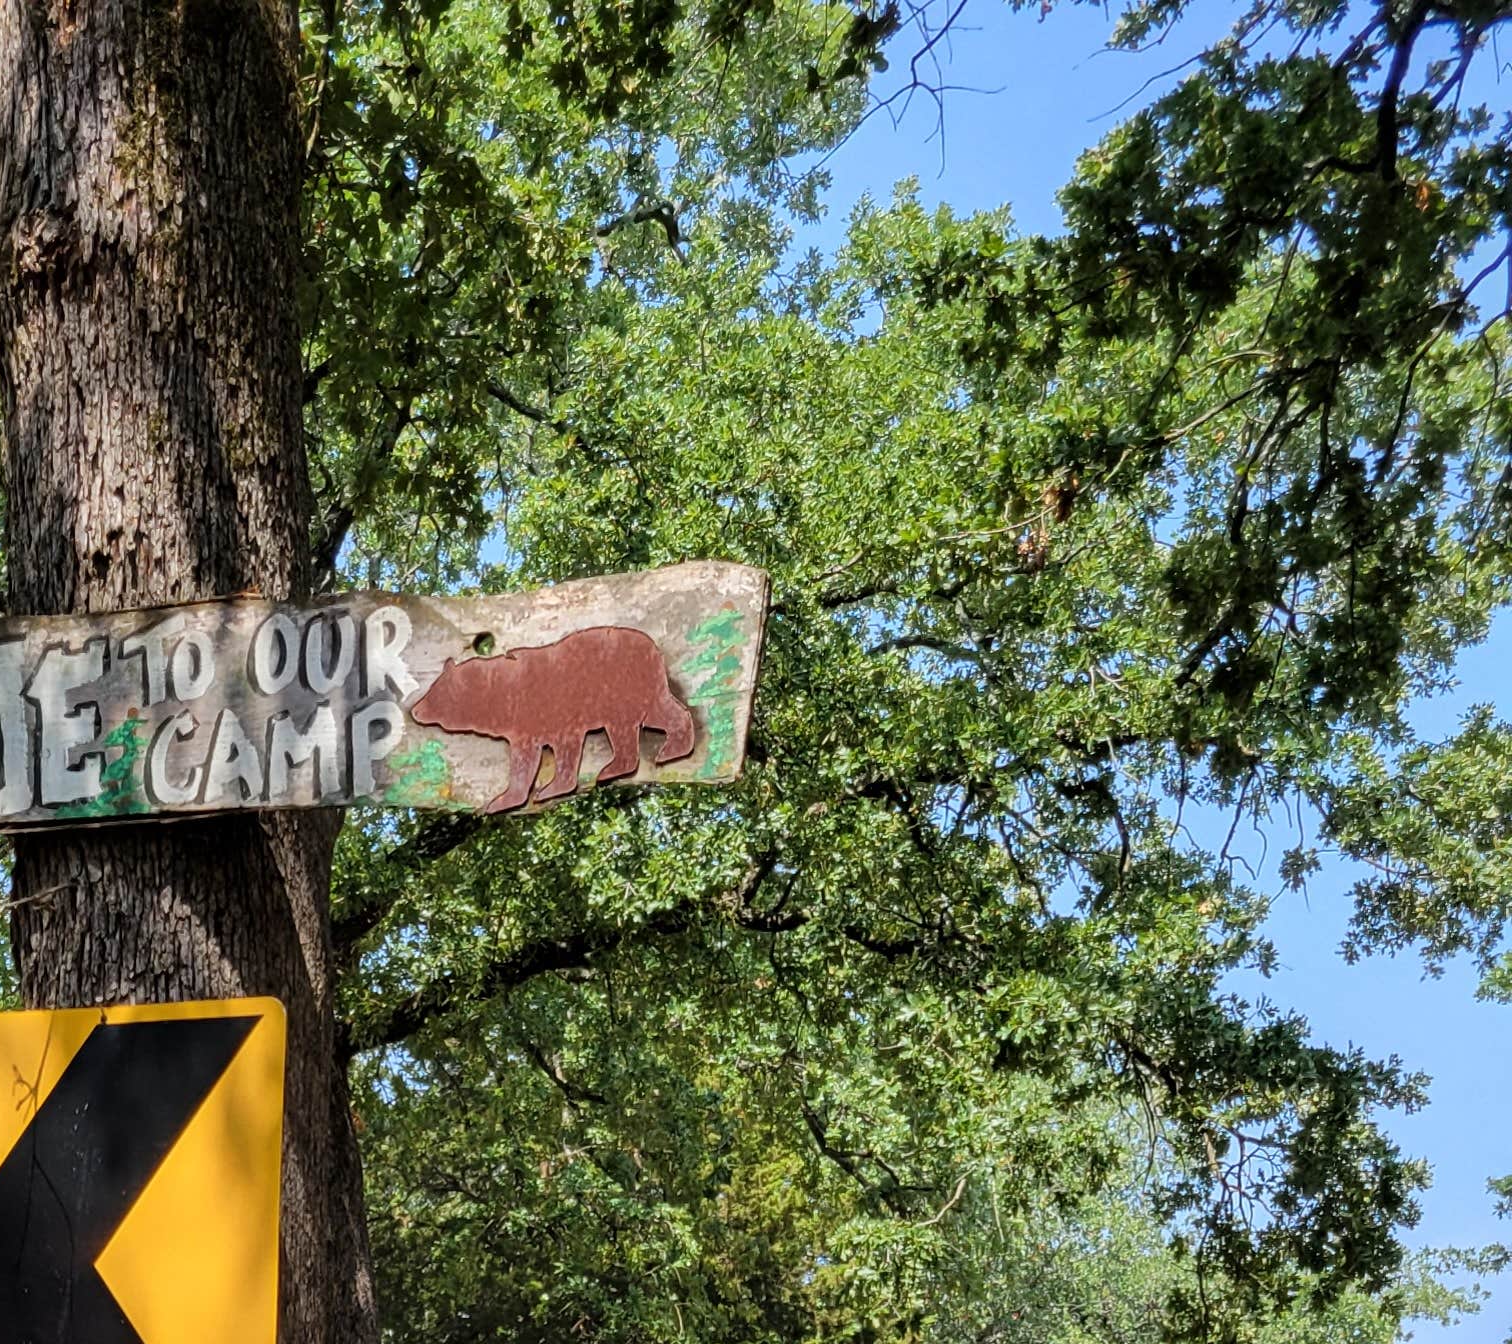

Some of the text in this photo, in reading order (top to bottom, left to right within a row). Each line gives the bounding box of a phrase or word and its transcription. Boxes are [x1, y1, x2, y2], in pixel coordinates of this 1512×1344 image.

[119, 605, 420, 704] TO OUR
[144, 700, 406, 805] CAMP
